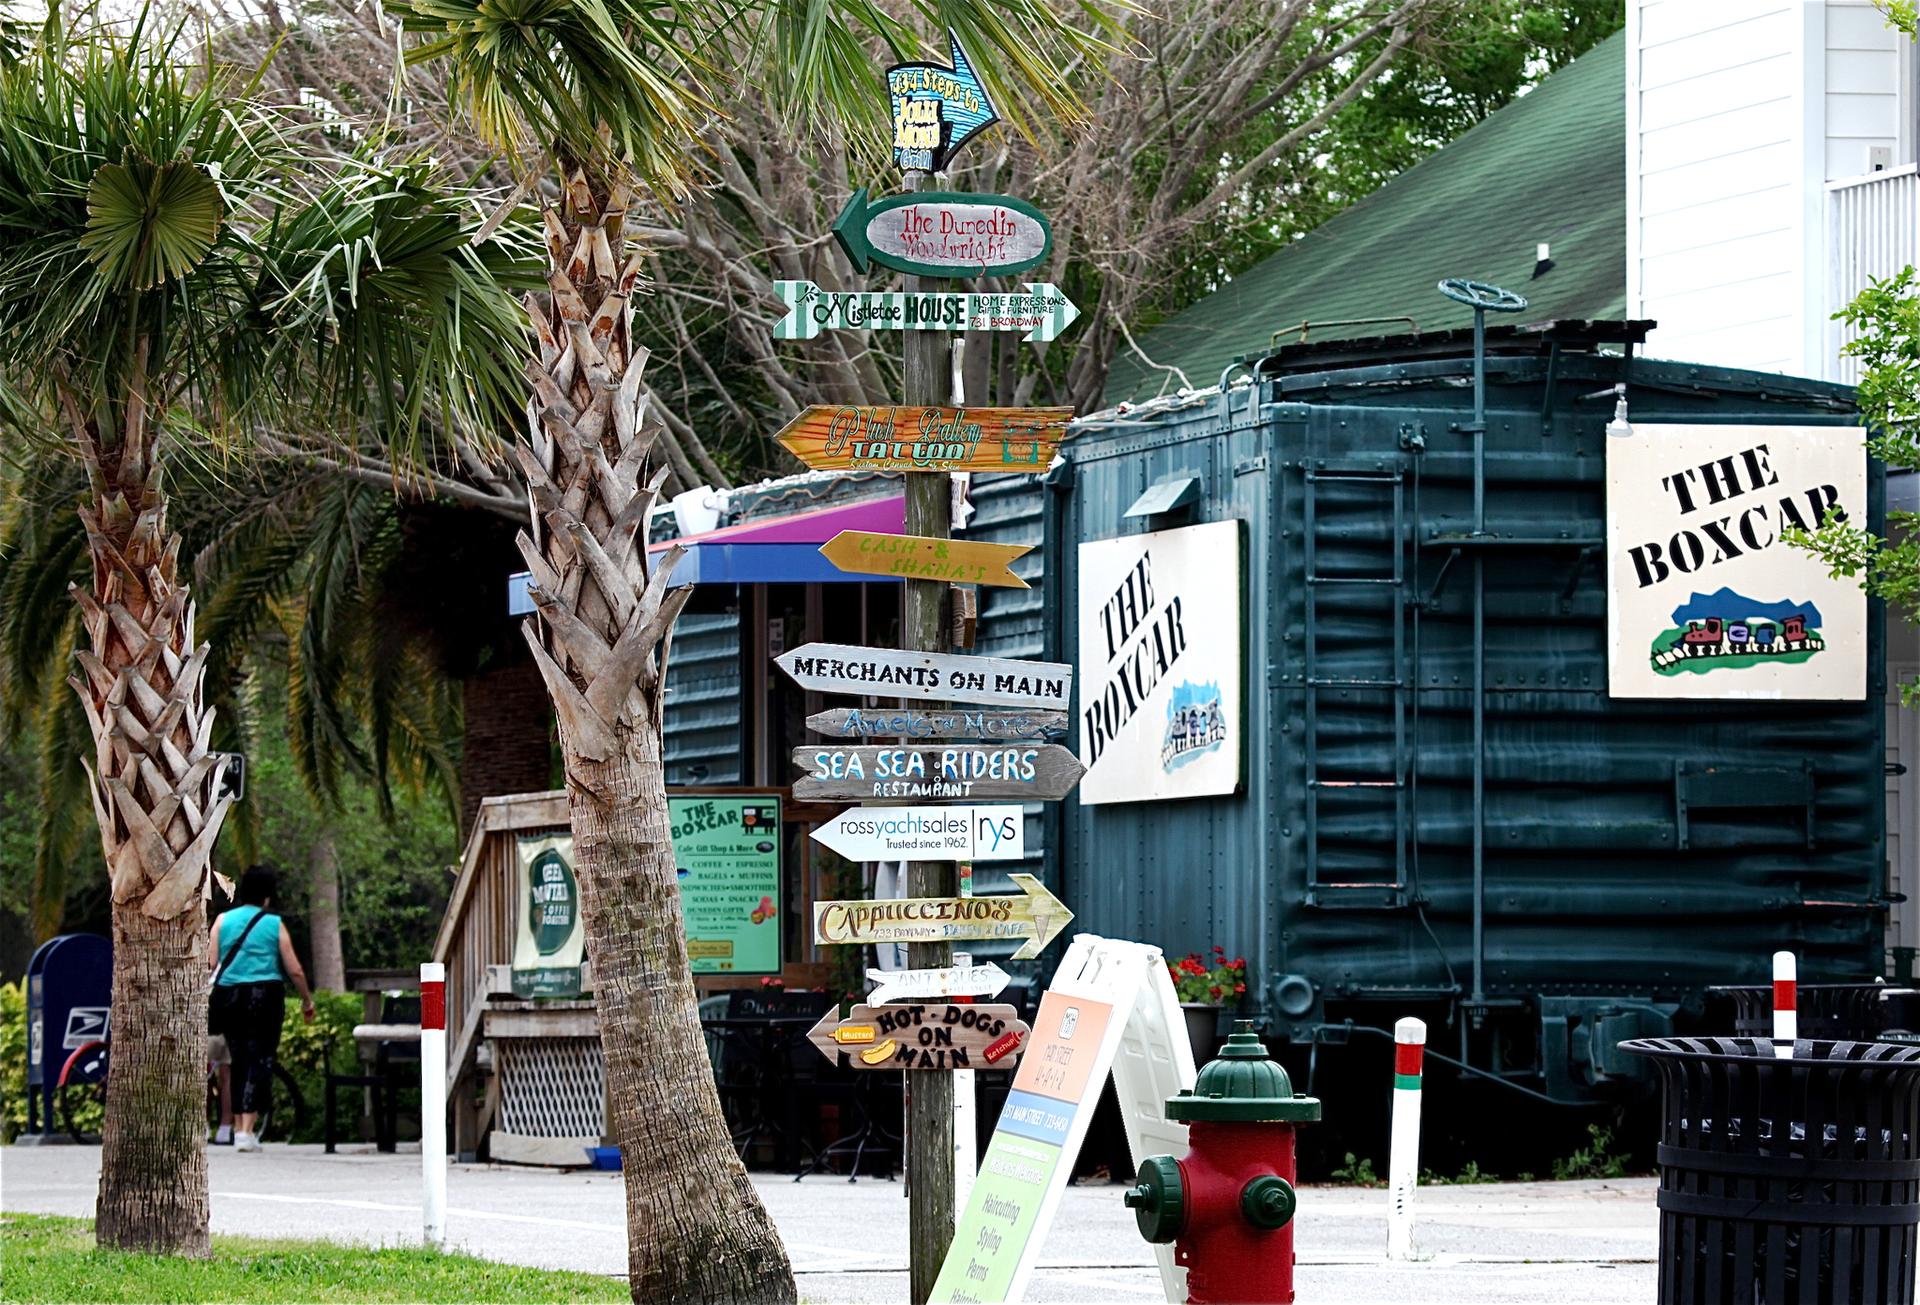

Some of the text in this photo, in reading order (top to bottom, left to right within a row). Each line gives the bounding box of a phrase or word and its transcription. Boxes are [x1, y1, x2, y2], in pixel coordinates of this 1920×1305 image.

[922, 67, 961, 101] Steps
[964, 88, 979, 114] to
[902, 206, 1016, 237] The Dunedin
[900, 232, 1006, 278] Woodwright
[813, 293, 966, 326] Mistletoe HOUSE
[974, 296, 1006, 307] HOME
[1007, 305, 1054, 315] FURNITURE
[991, 316, 1045, 328] BROADWAY
[850, 441, 966, 460] TATTOO
[1661, 444, 1779, 515] THE
[859, 537, 949, 560] CASH &
[1628, 484, 1849, 588] BOXCAR
[1100, 549, 1155, 664] THE
[793, 656, 1063, 699] MERCHANTS ON MAIN
[1084, 595, 1187, 768] BOXCAR
[814, 749, 1039, 782] SEA SEA RIDERS
[873, 780, 974, 797] RESTAURANT
[671, 810, 739, 839] BOXCAR
[682, 801, 716, 821] THE
[841, 812, 1016, 852] rossyachtsales rys
[886, 838, 918, 849] Trusted
[919, 838, 941, 849] since
[899, 969, 991, 986] ANTQUES
[876, 1005, 1006, 1037] HOT DOGS
[918, 1027, 953, 1047] ON
[895, 1044, 970, 1068] MAIN
[982, 1192, 1020, 1226] Haircutting
[977, 1225, 1002, 1256] Styling
[965, 1257, 989, 1282] Perms
